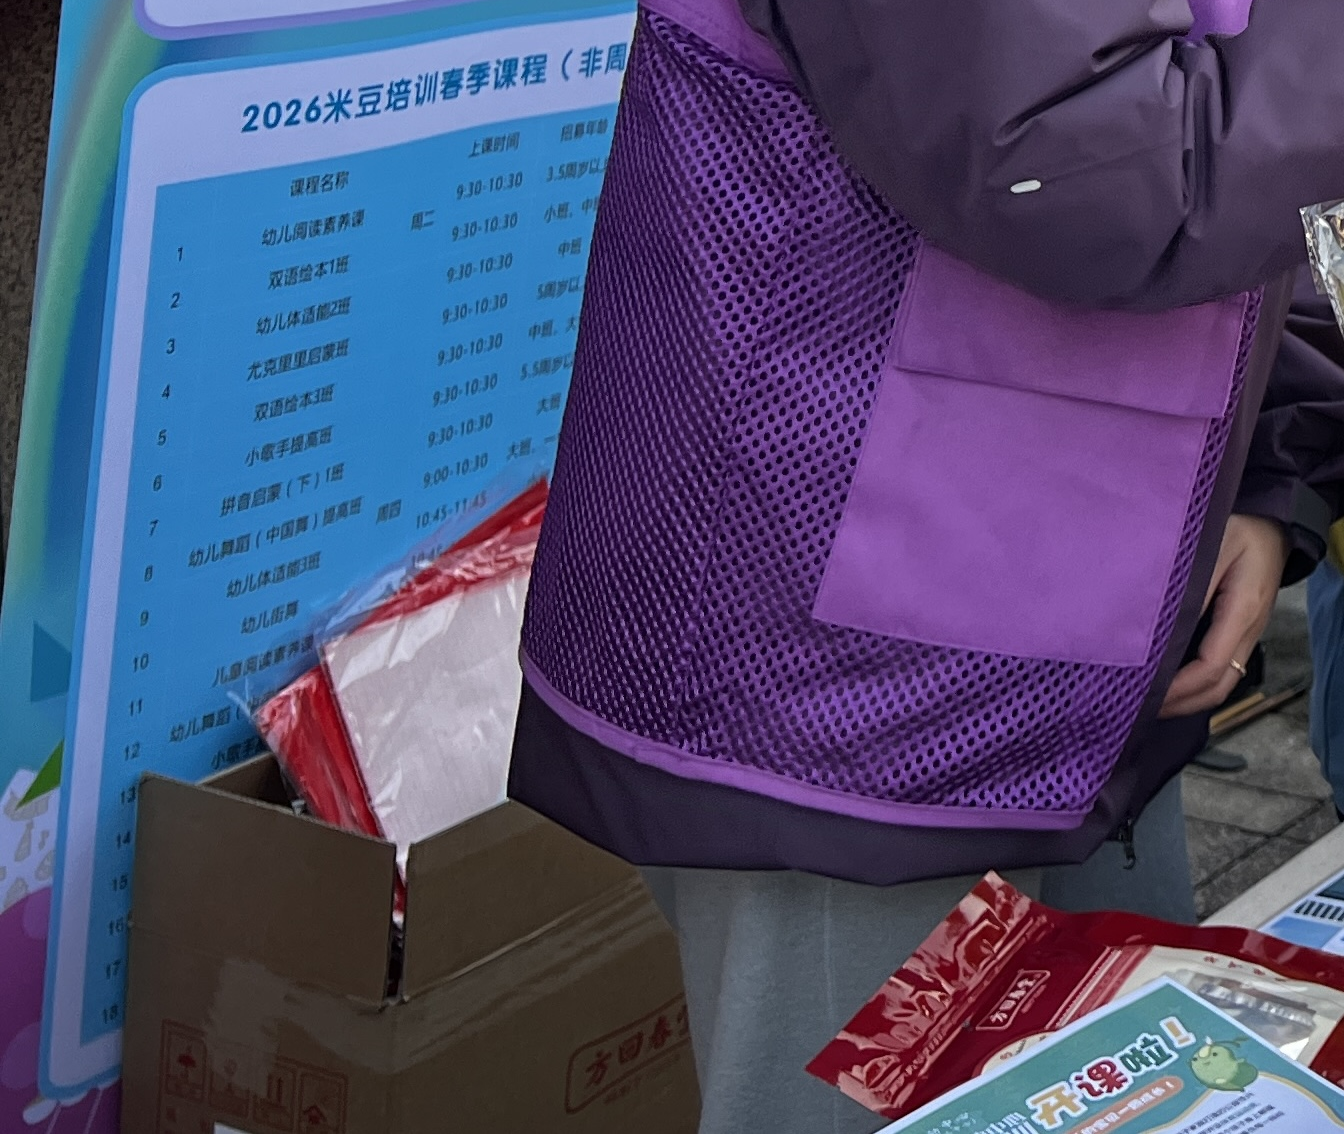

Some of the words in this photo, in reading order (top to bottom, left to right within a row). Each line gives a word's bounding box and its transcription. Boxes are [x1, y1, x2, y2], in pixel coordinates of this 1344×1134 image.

[290, 171, 349, 197] 课程名称
[468, 131, 520, 158] 上课时间
[170, 292, 180, 309] 2
[452, 212, 518, 242] 9:30-10:30
[176, 246, 184, 262] 1
[457, 171, 523, 200] 9:30-10:30
[162, 384, 171, 400] 4
[442, 293, 508, 325] 9:30-10:30
[166, 338, 175, 355] 3
[447, 252, 513, 283] 9:30-10:30
[153, 475, 162, 492] 6
[433, 373, 498, 407] 9:30-10:30
[157, 429, 167, 446] 5
[438, 333, 503, 366] 9:30-10:30
[149, 519, 158, 536] 7
[428, 412, 493, 448] 9:30-10:30
[133, 653, 149, 672] 10
[139, 610, 149, 627] 9
[125, 742, 141, 762] 12
[130, 699, 143, 717] 11
